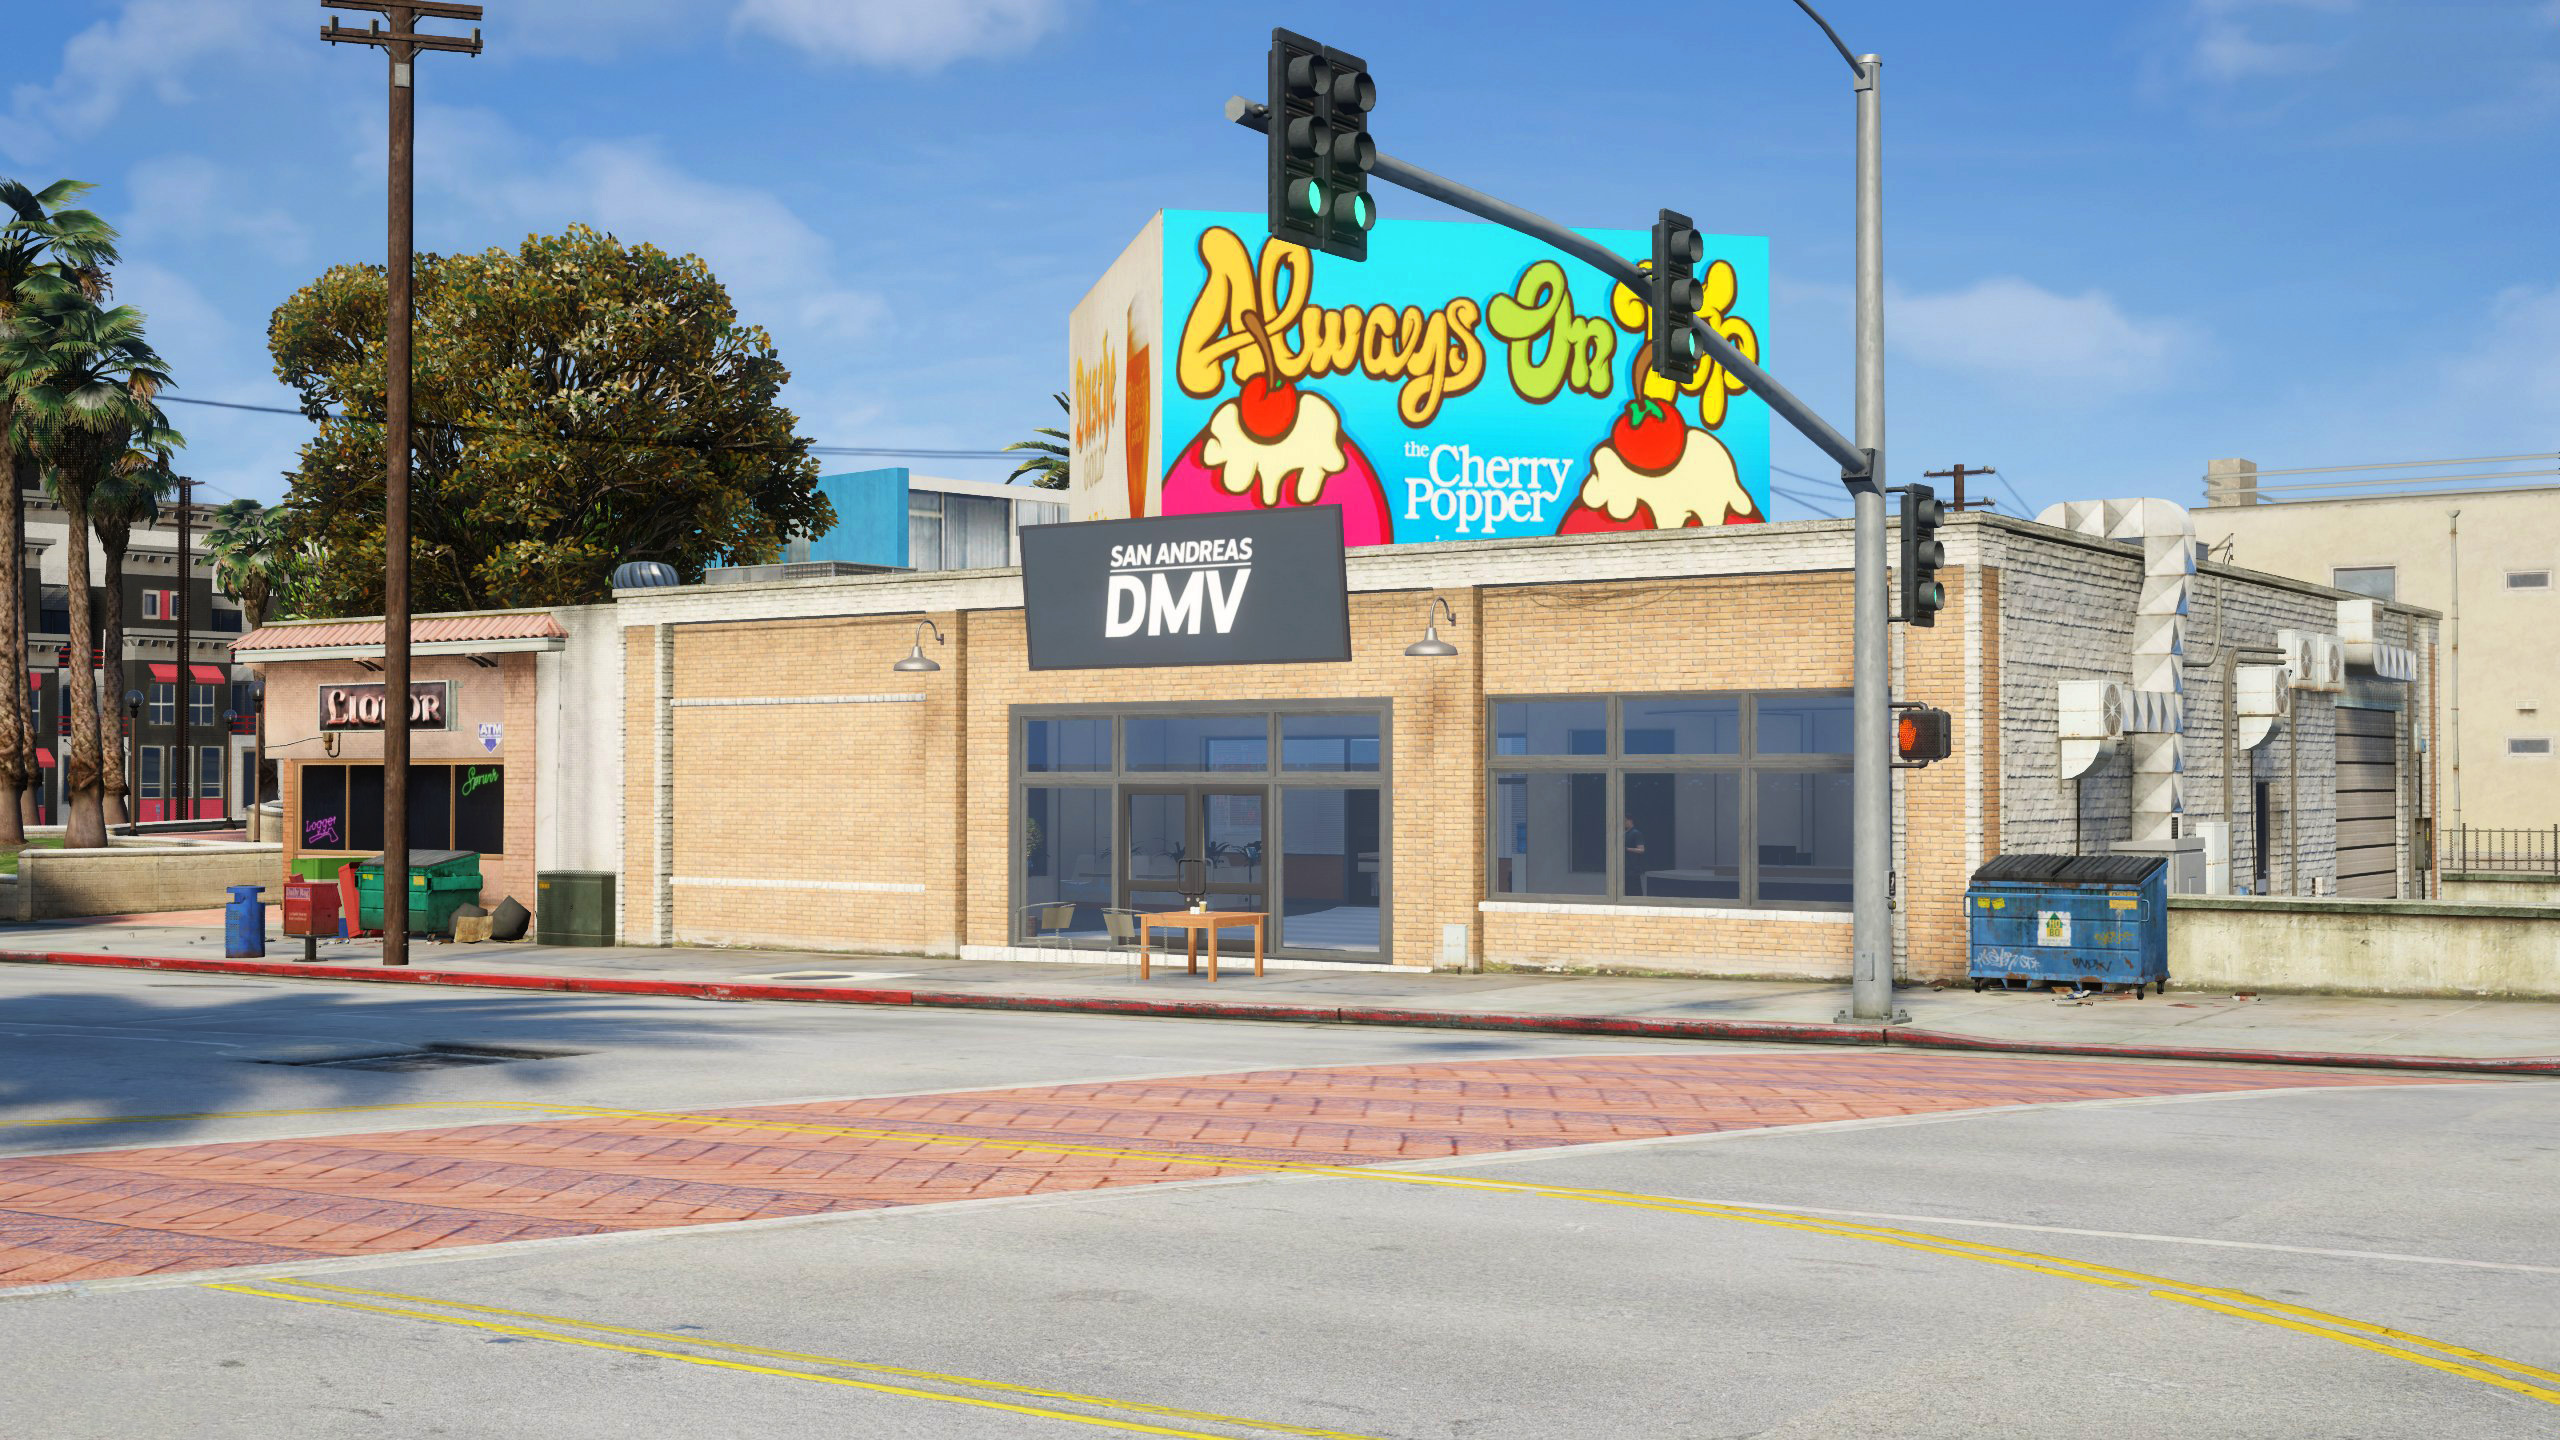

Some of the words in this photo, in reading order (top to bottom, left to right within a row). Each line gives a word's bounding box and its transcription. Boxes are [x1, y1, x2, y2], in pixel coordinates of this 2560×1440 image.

[1177, 226, 1486, 428] Always
[1486, 260, 1617, 405] On
[1084, 445, 1105, 491] GOLD
[1404, 441, 1429, 457] the
[1429, 444, 1573, 502] Cherry
[1404, 478, 1544, 533] Popper
[1110, 543, 1152, 567] SAN
[1155, 537, 1252, 564] ANDREAS
[1105, 568, 1251, 637] DMV
[480, 723, 502, 736] ATM
[305, 815, 336, 835] Logger
